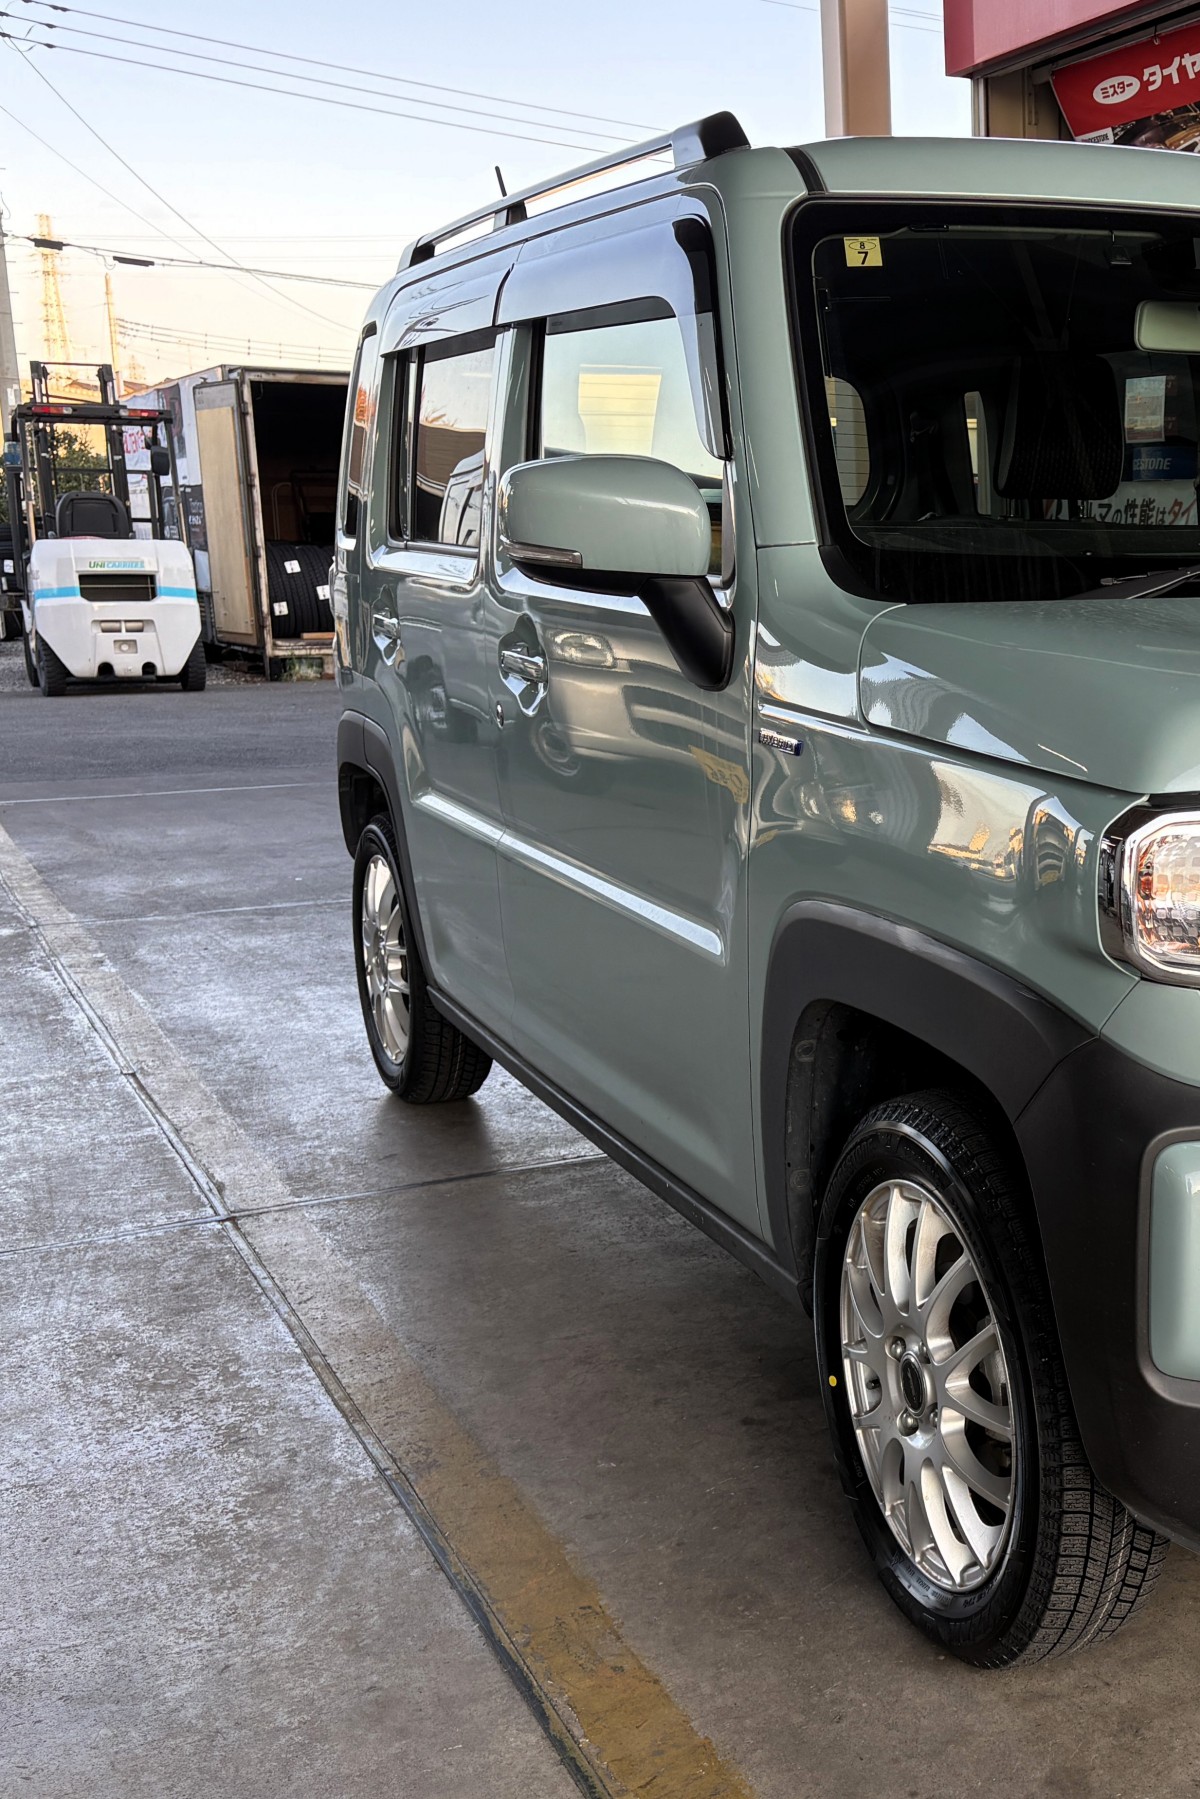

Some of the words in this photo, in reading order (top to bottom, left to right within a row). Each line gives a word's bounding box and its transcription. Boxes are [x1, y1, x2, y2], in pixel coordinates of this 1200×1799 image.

[1100, 80, 1134, 99] ミスター
[858, 251, 868, 265] 7
